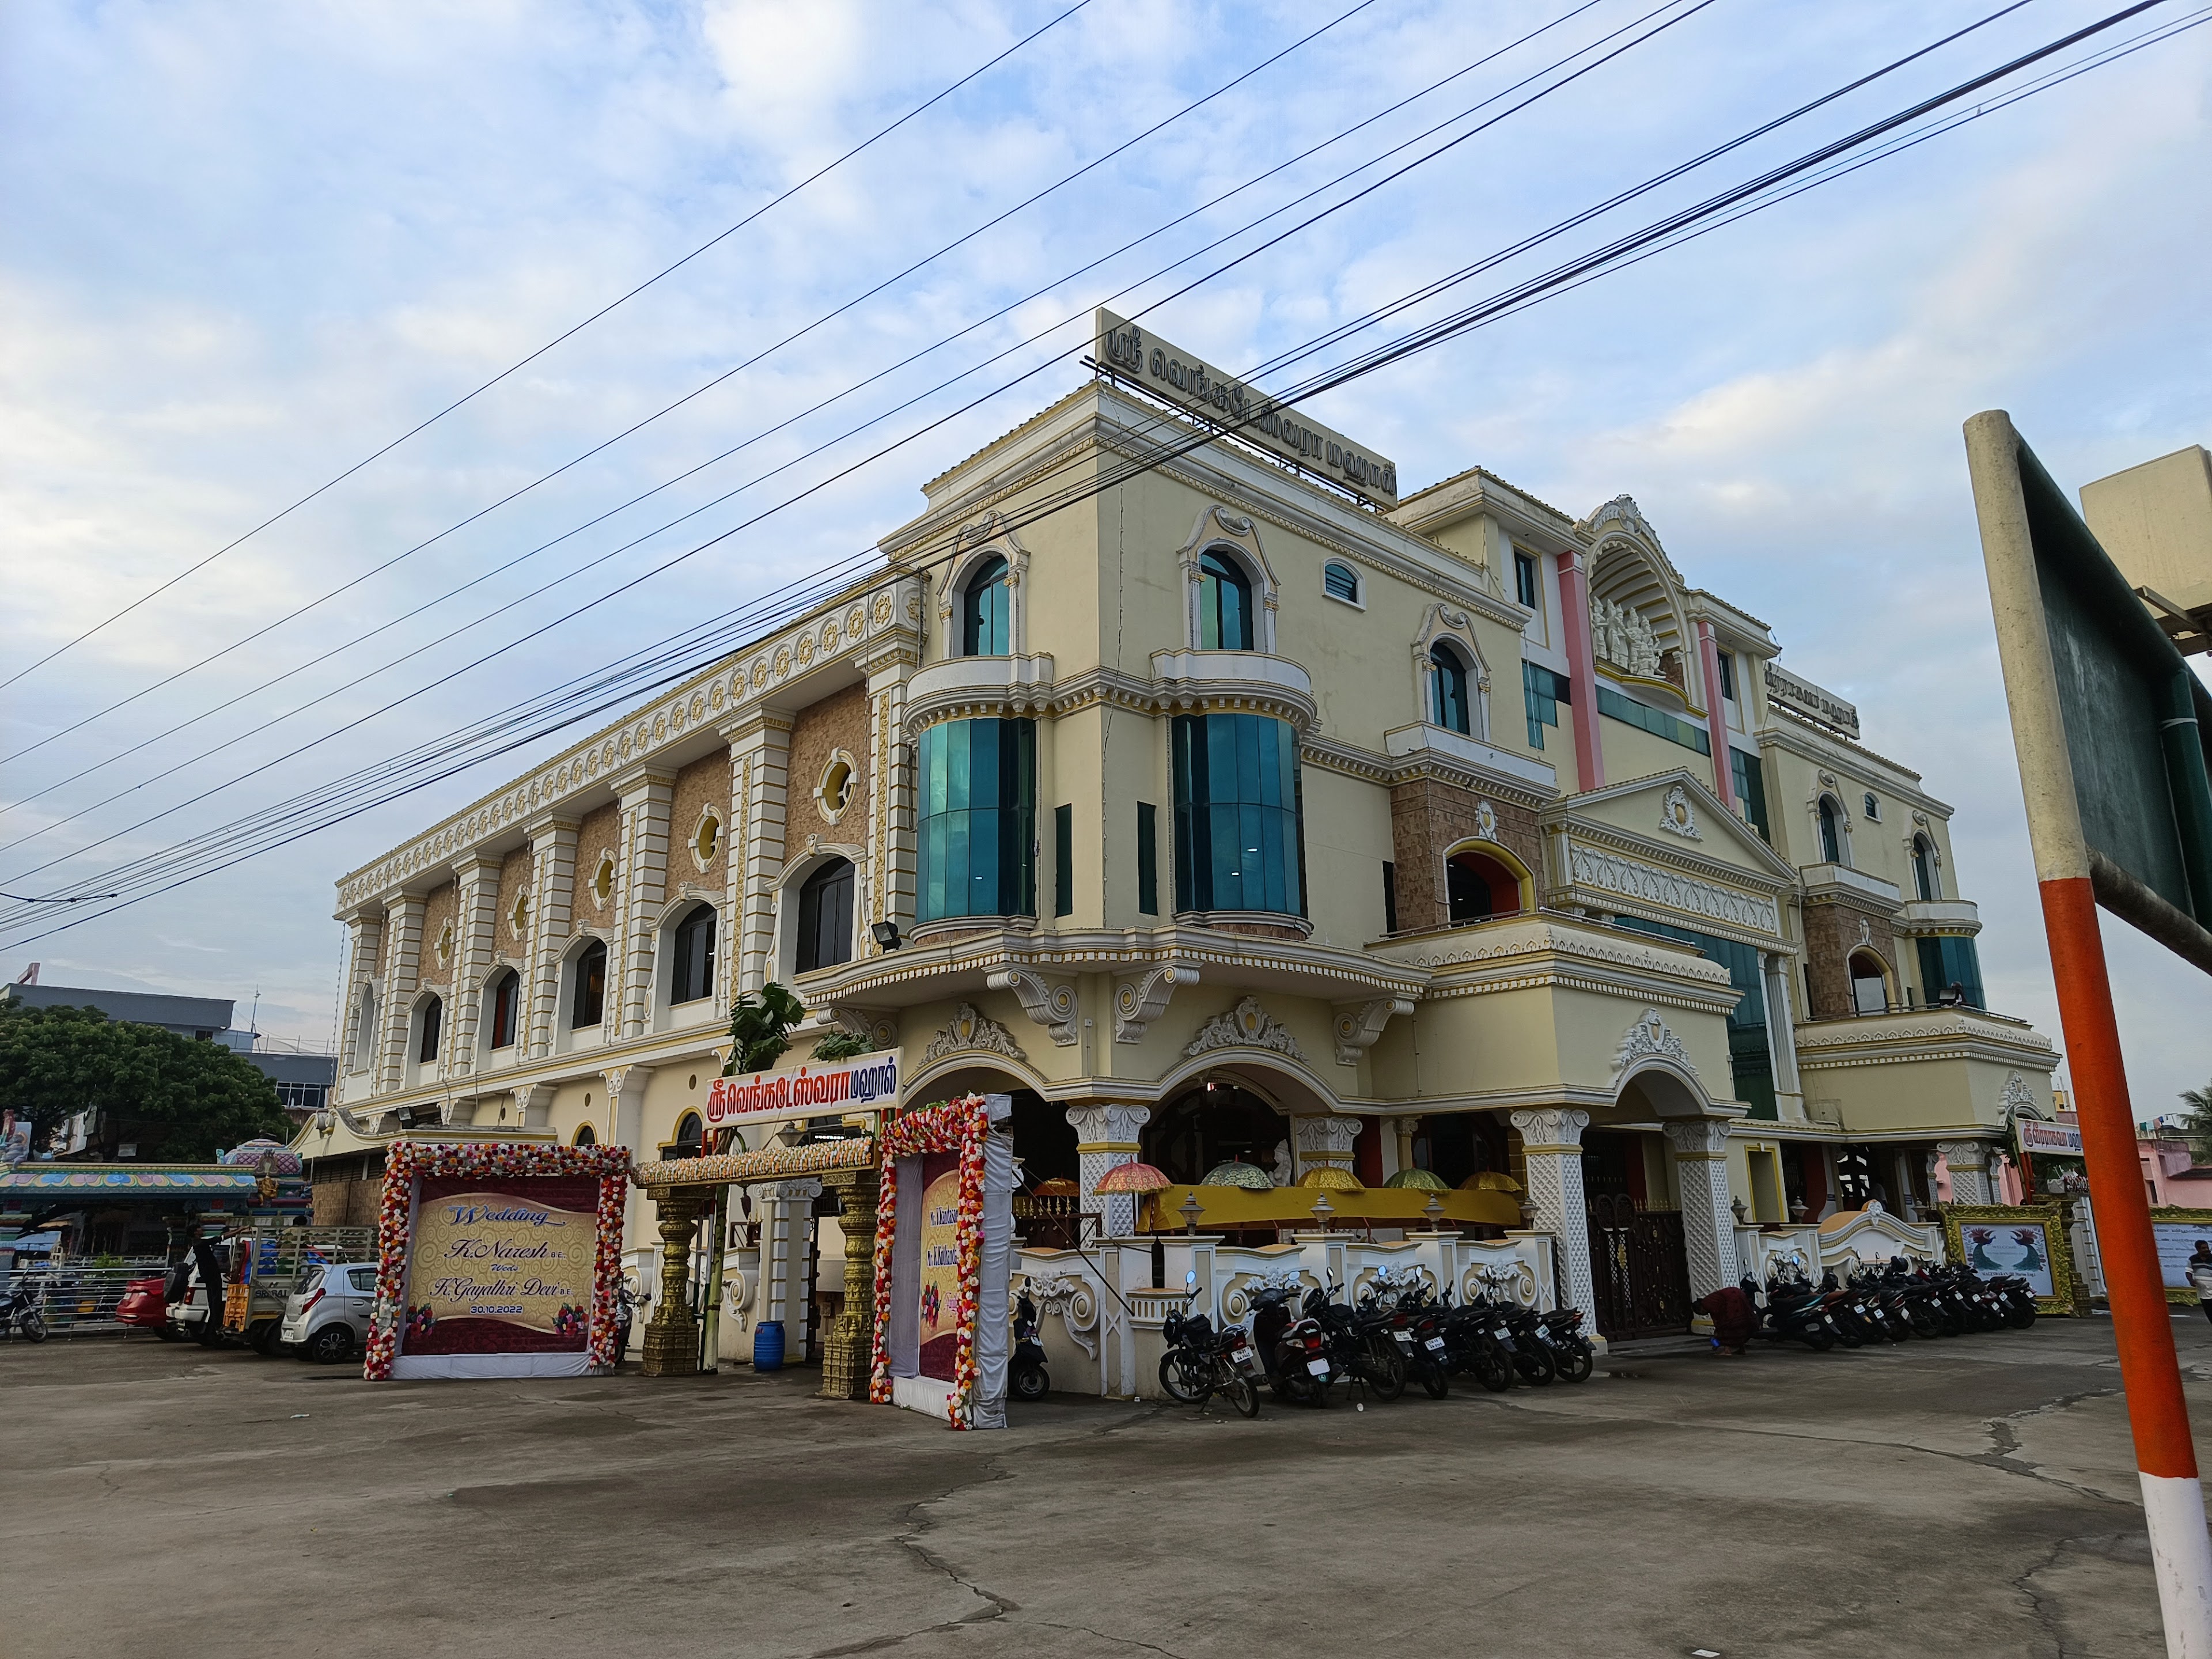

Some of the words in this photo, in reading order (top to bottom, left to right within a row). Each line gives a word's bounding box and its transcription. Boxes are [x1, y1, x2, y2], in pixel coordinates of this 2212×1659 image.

[850, 1055, 897, 1104] மஹால்
[448, 1205, 567, 1227] Wedding
[490, 1263, 518, 1272] Weds
[520, 1277, 560, 1296] Devi
[469, 1305, 523, 1314] 30.10.2022
